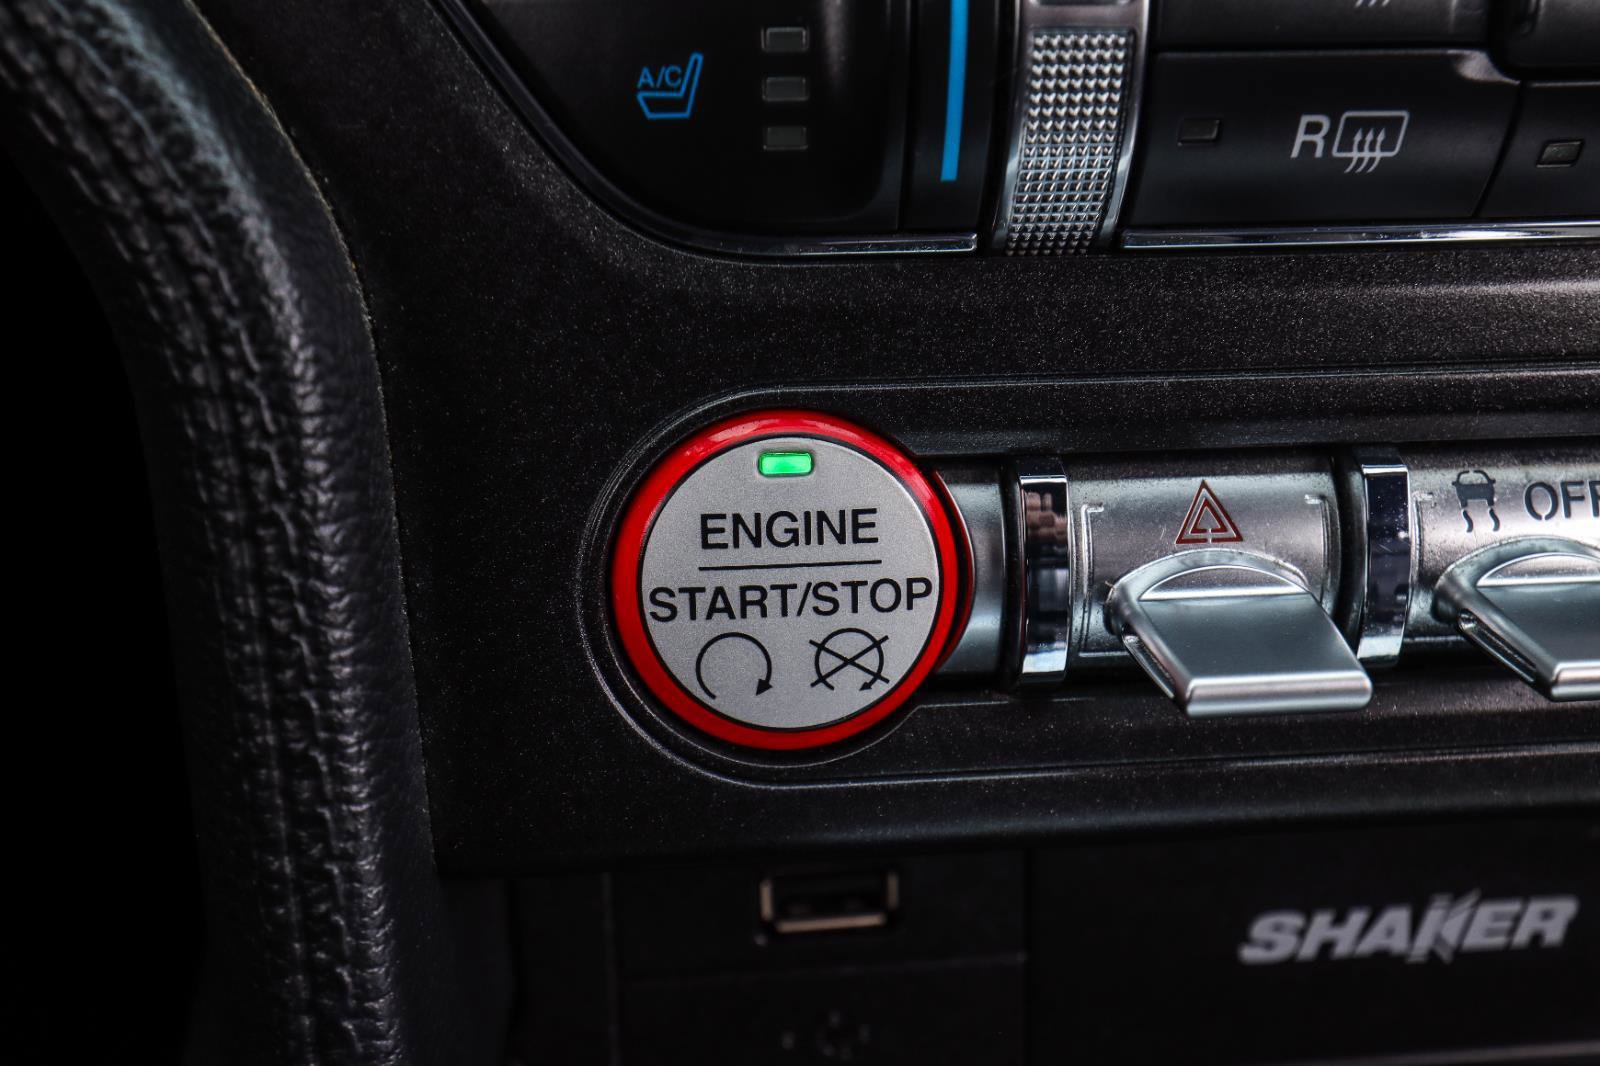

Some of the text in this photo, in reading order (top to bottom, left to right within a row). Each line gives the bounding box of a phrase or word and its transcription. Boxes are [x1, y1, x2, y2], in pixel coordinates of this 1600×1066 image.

[637, 65, 682, 88] A/C
[1290, 114, 1329, 158] R
[700, 507, 879, 550] ENGINE
[649, 577, 933, 623] START/STOP
[1238, 888, 1578, 963] SHAKER
